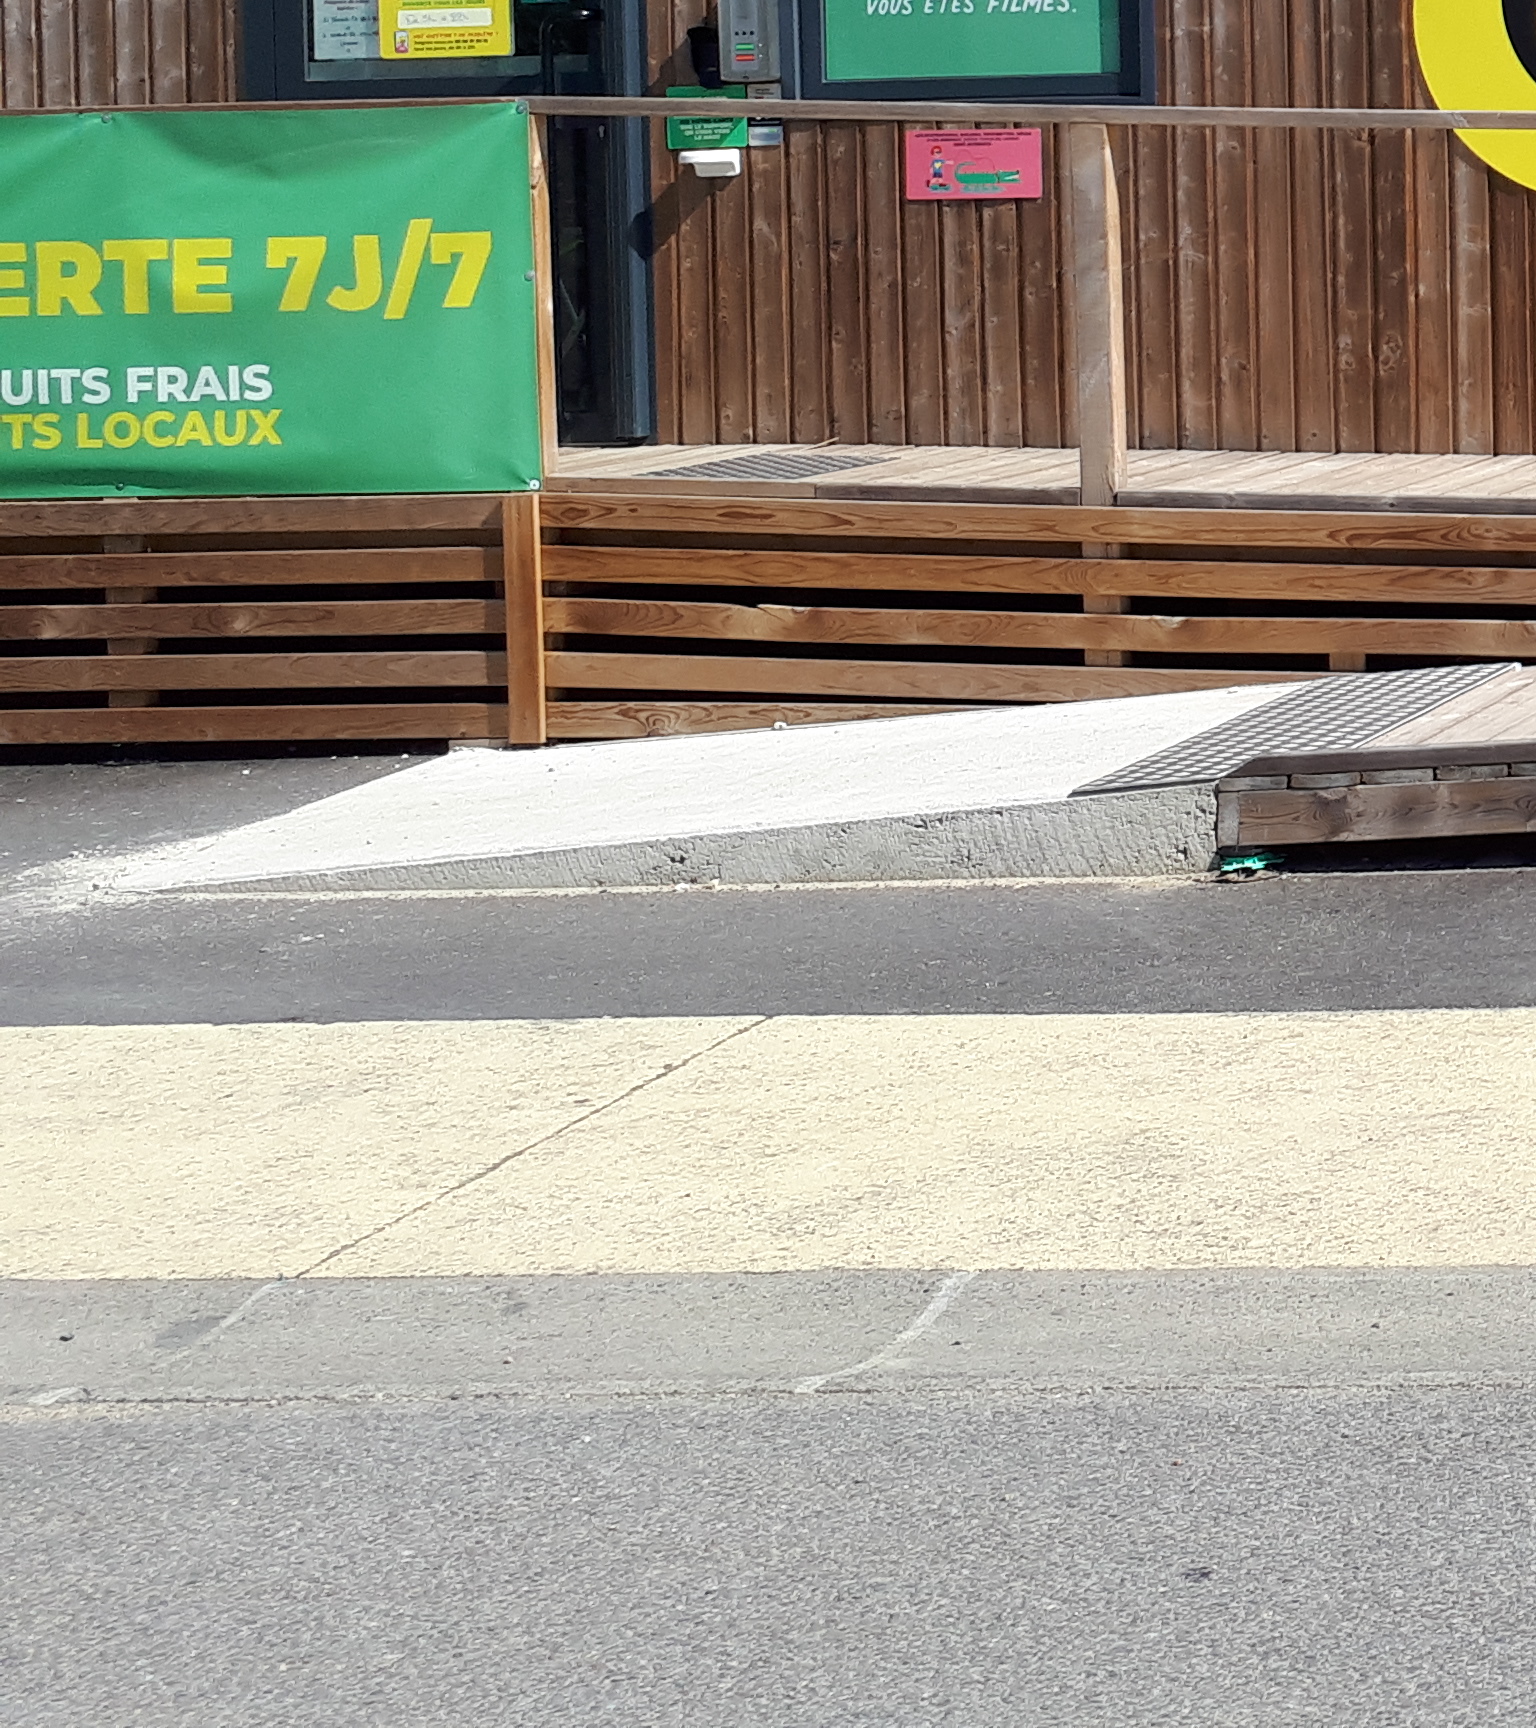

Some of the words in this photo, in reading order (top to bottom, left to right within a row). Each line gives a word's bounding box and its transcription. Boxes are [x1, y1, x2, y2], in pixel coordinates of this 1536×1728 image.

[265, 217, 493, 321] 7J/7
[0, 367, 111, 406] UITS
[126, 363, 274, 403] FRAIS
[0, 412, 63, 450] TS
[76, 408, 283, 449] LOCAUX
